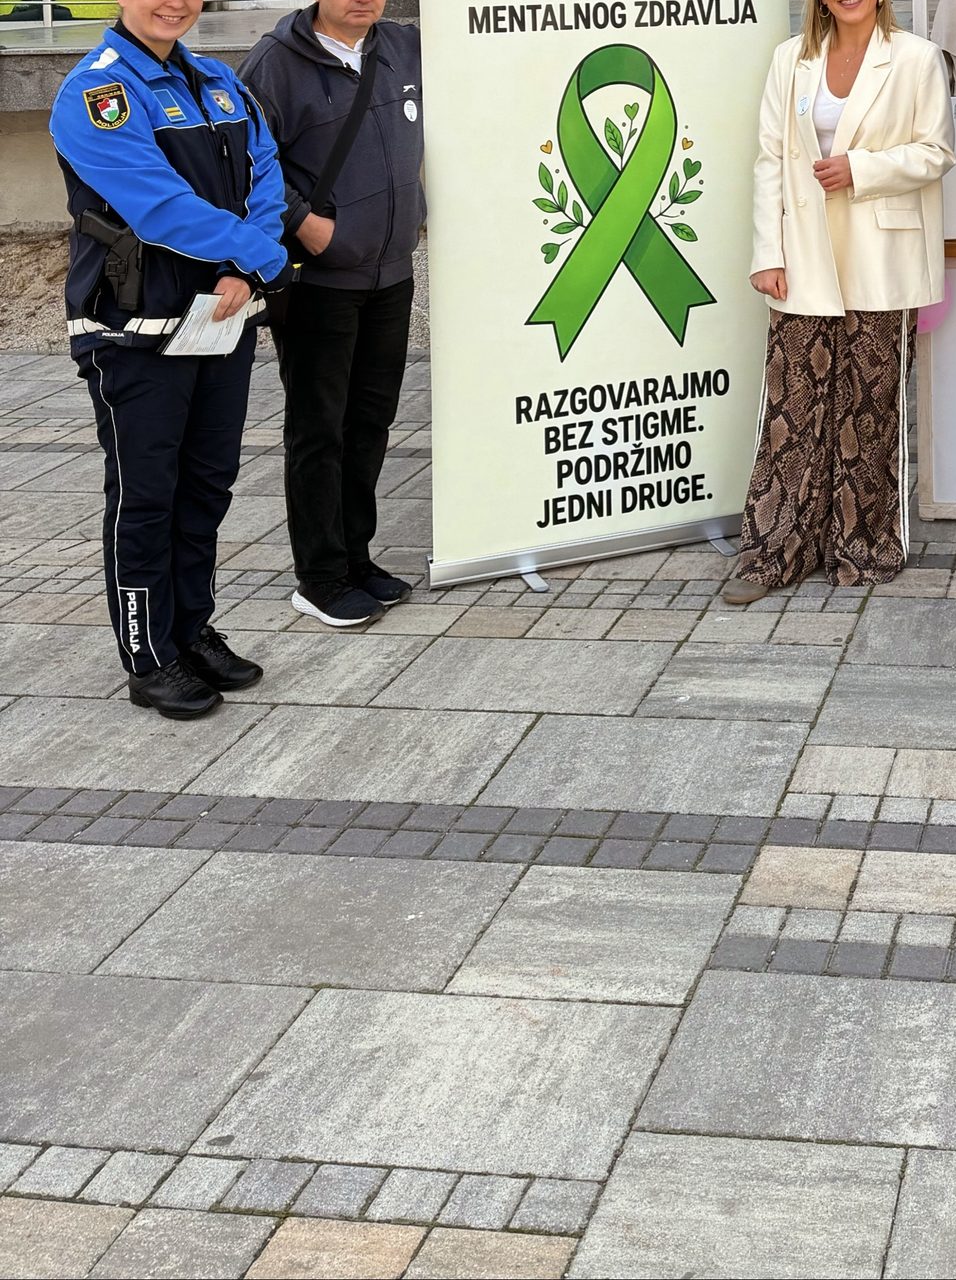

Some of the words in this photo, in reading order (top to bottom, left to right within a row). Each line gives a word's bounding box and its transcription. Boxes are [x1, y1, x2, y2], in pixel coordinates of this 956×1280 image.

[468, 3, 627, 34] MENTALNOG
[515, 368, 730, 425] RAZGOVARAJMO
[544, 420, 593, 455] BEZ
[602, 406, 704, 447] STIGME.
[556, 441, 692, 489] PODRŽIMO
[536, 488, 612, 529] JEDNI
[621, 473, 713, 515] DRUGE.
[126, 591, 141, 654] POLICIJA
